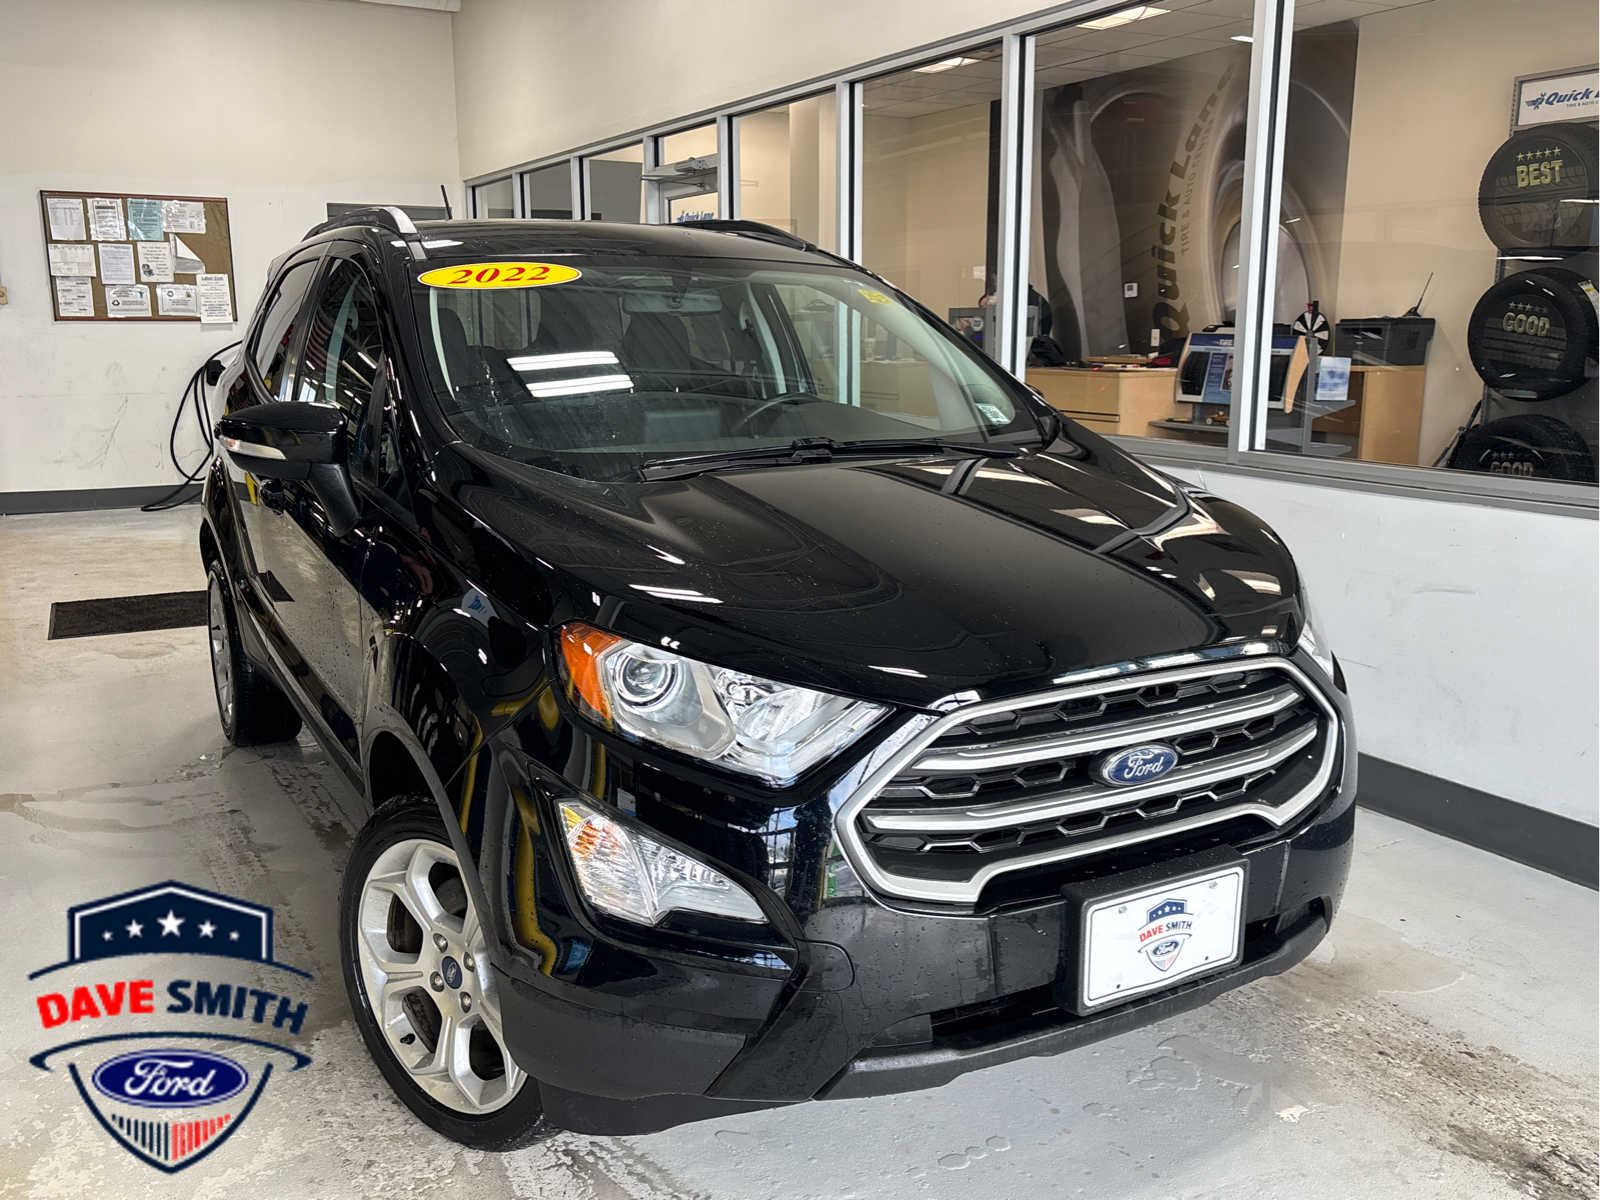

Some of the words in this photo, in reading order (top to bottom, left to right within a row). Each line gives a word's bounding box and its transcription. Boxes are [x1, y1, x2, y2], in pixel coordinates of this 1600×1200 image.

[1545, 88, 1593, 105] Quick
[1170, 64, 1233, 180] Lane
[1516, 160, 1563, 188] BEST
[1181, 223, 1190, 255] TIRE
[448, 266, 550, 285] 2022
[1152, 189, 1190, 339] Quick
[1503, 312, 1550, 337] GOOD
[1124, 751, 1164, 779] Ford
[1139, 924, 1163, 942] DAVE
[1165, 920, 1192, 932] SMITH
